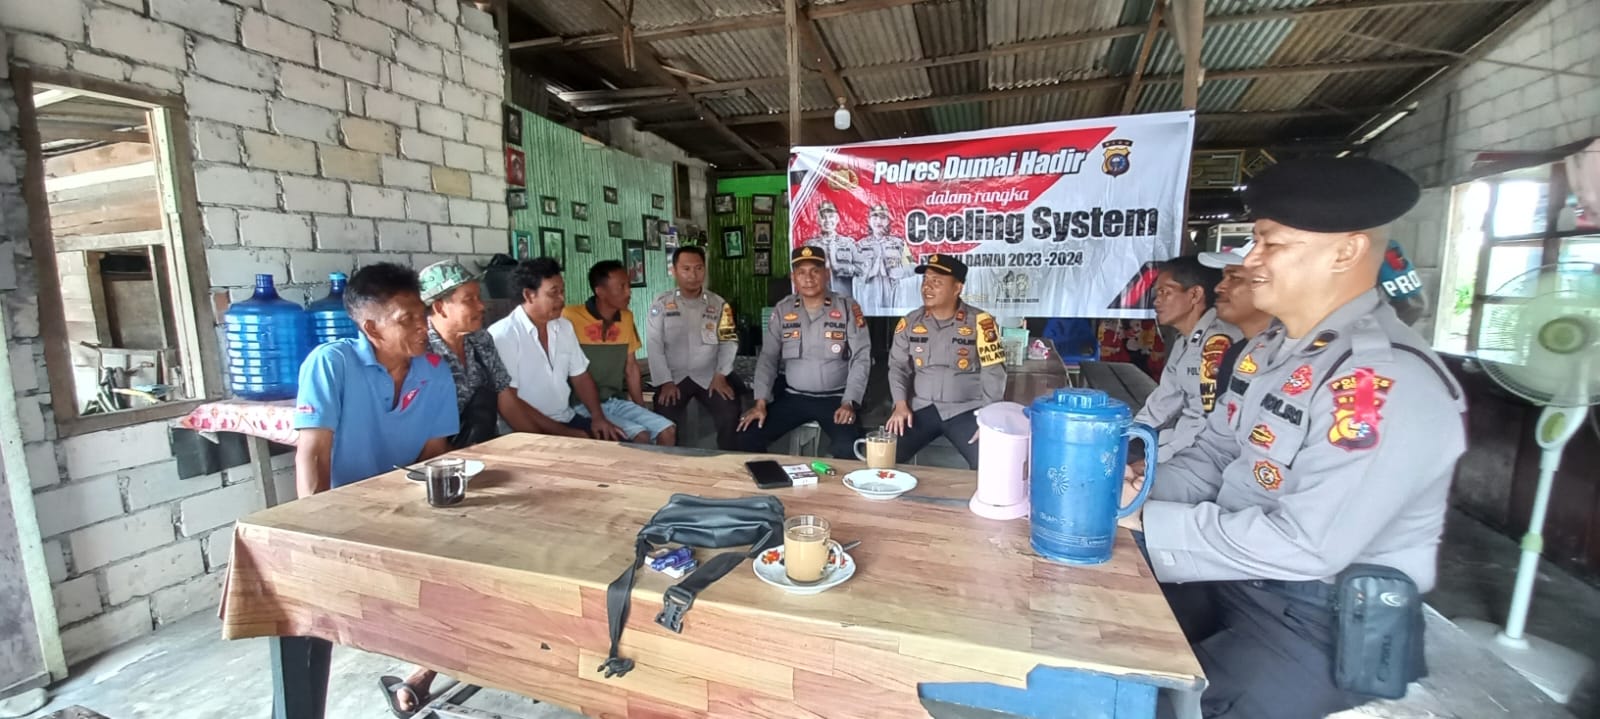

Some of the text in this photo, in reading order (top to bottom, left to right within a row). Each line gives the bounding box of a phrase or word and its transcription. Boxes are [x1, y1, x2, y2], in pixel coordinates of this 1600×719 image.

[873, 147, 1088, 184] Polres Dumai Hadir
[926, 188, 1029, 207] dalam rangka
[907, 206, 1159, 245] Cooling System
[965, 253, 1006, 267] DAMAI
[1007, 252, 1042, 267] 2023
